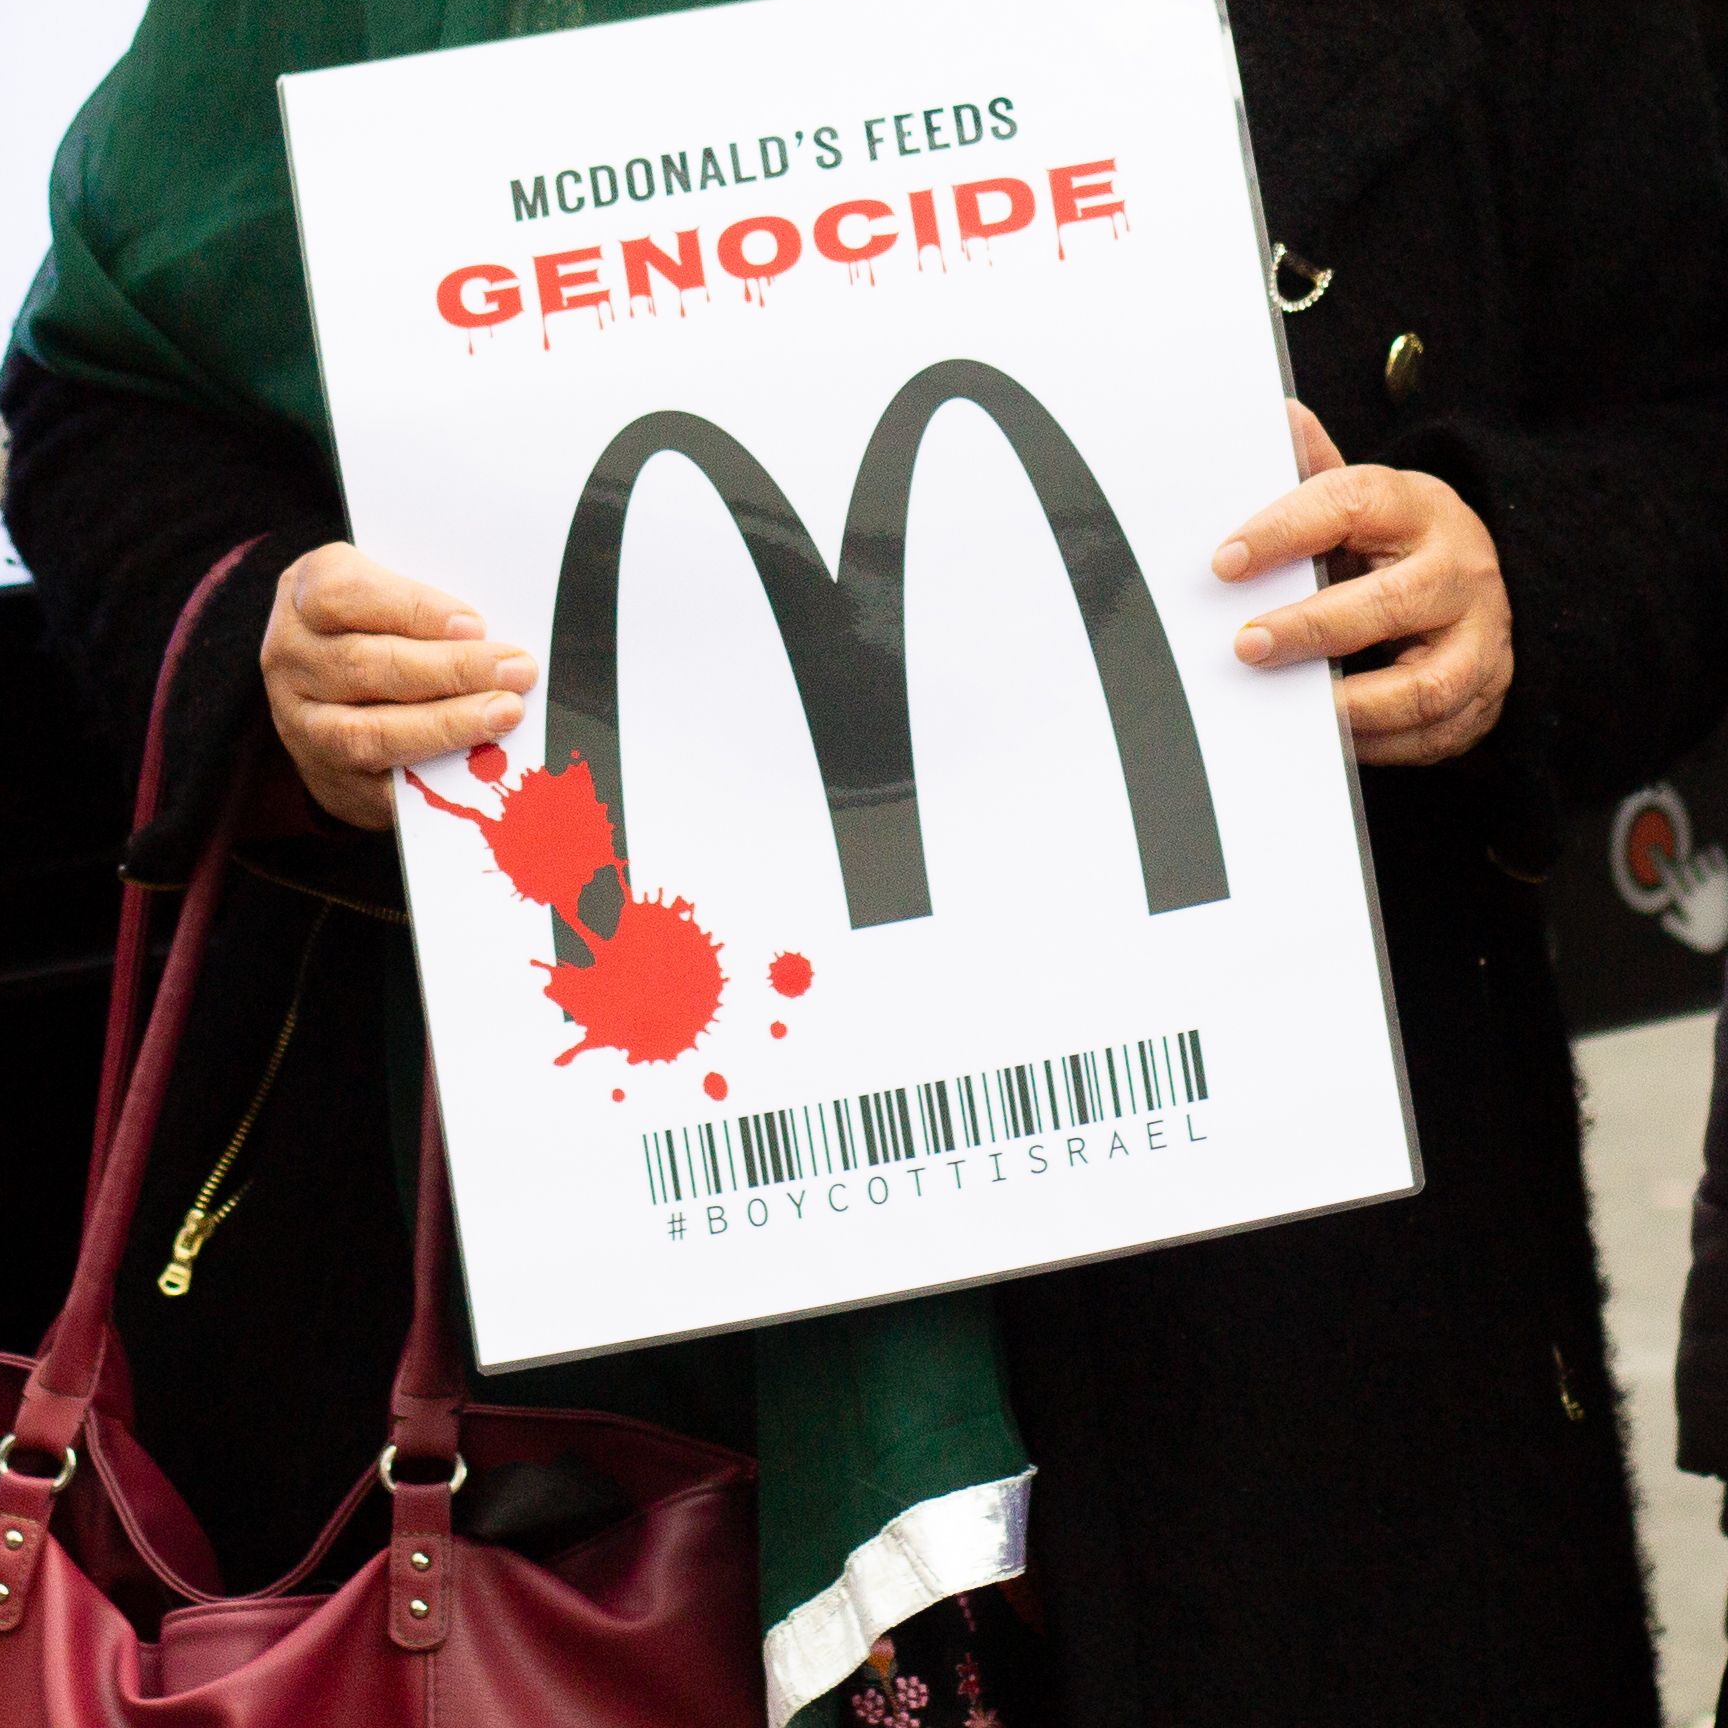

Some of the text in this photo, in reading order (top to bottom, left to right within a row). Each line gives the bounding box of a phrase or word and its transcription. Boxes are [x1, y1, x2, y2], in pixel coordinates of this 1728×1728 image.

[510, 96, 1018, 222] MCDONALD'S FEEDS
[436, 158, 1130, 354] GENOCIDE
[667, 1113, 1208, 1241] #BOYCOTTISRAEL
